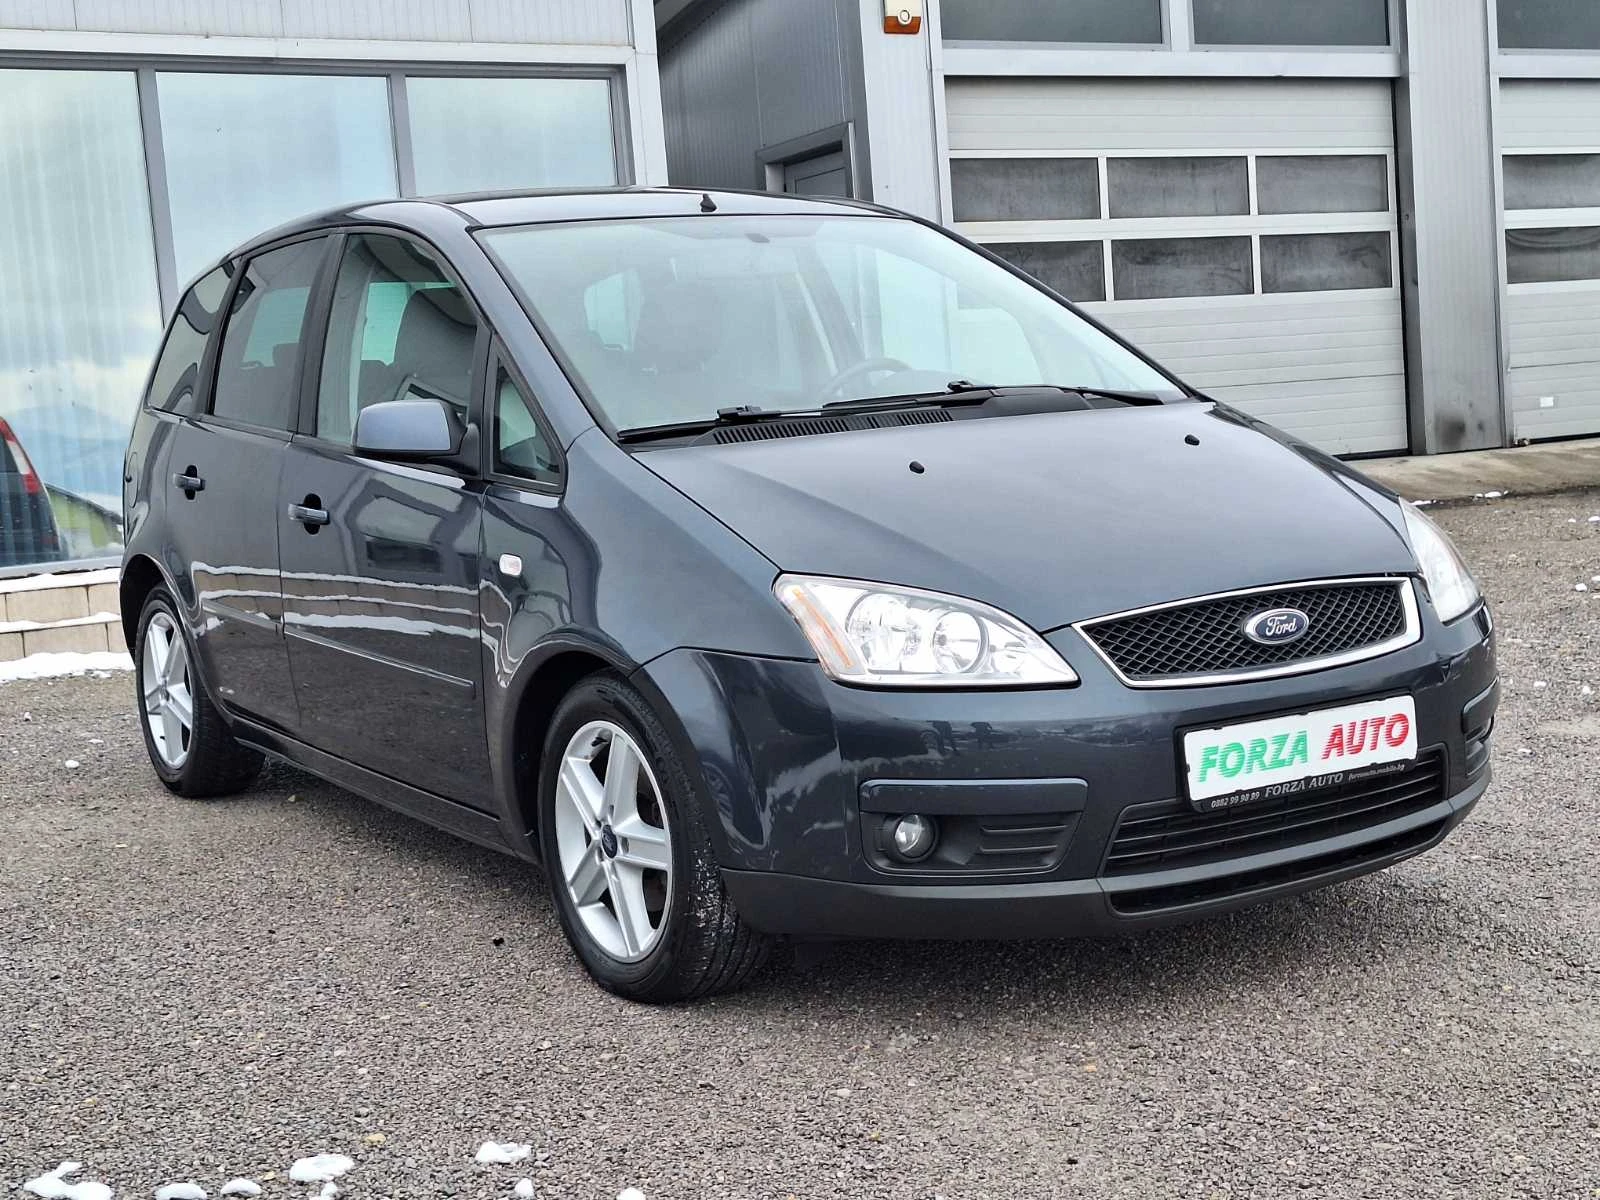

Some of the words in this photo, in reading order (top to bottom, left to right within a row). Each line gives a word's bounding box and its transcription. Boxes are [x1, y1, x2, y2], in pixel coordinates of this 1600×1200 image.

[1265, 615, 1297, 636] Ford
[1197, 730, 1308, 783] FORZA
[1321, 713, 1409, 760] AUTO
[1265, 780, 1305, 797] FORZA
[1309, 773, 1343, 789] AUTO
